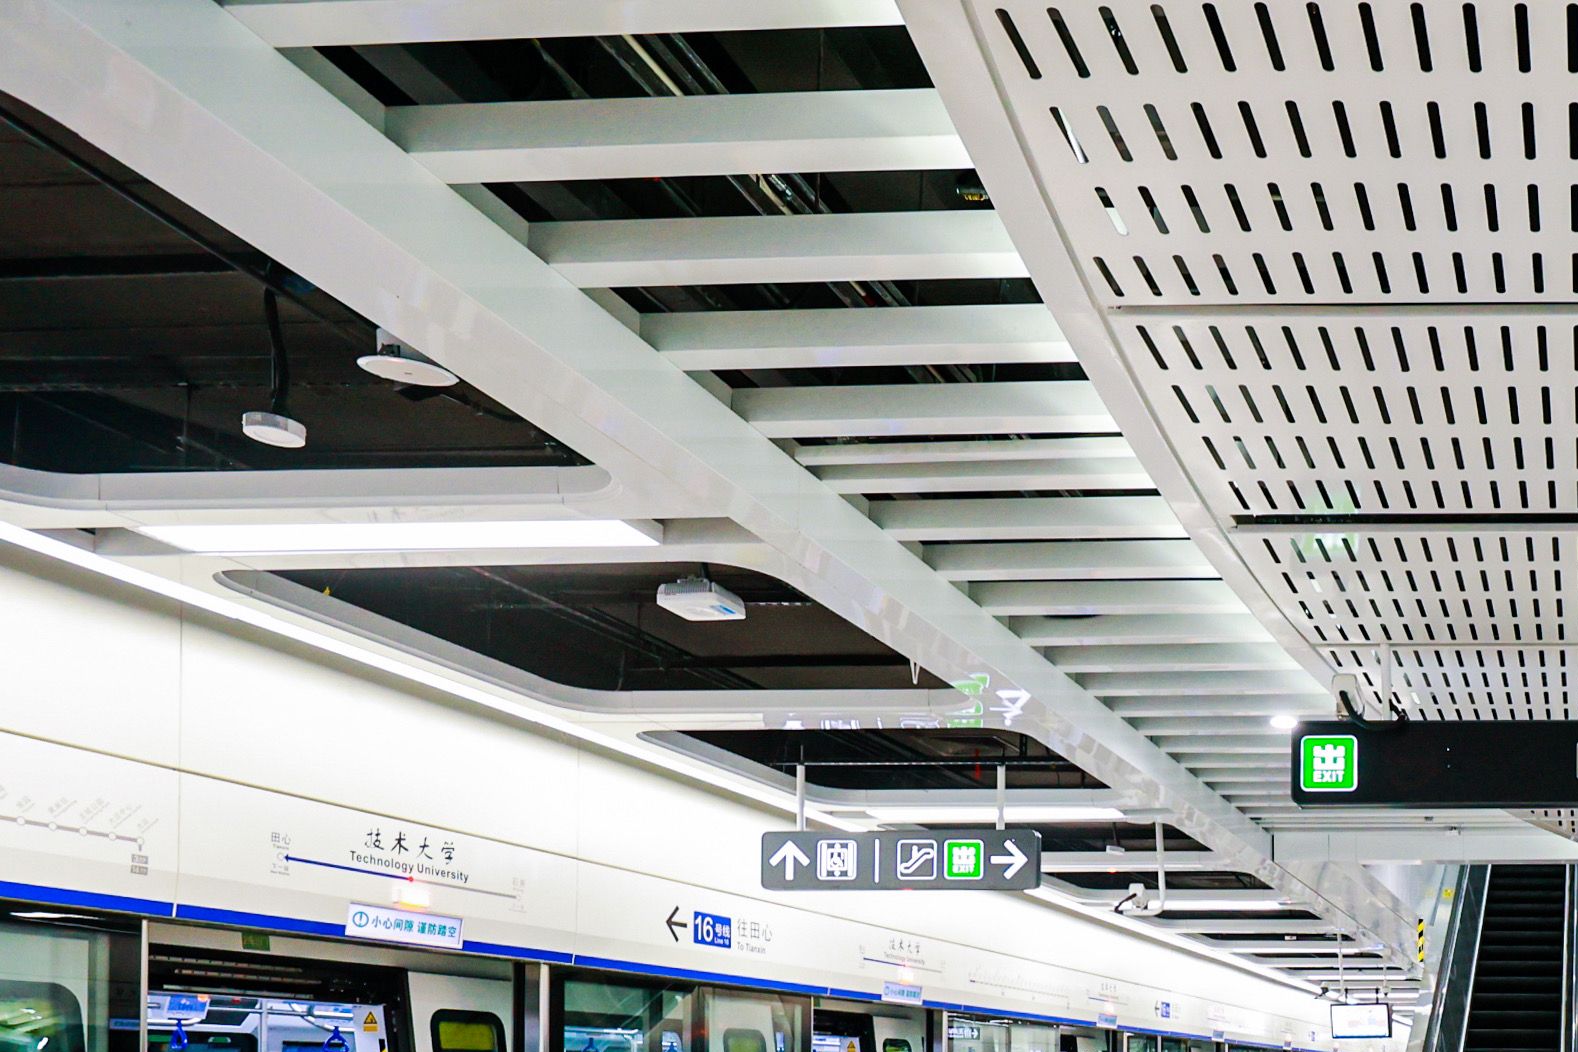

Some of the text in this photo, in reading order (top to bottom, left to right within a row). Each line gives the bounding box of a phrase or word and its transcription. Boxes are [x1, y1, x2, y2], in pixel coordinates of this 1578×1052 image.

[1313, 770, 1345, 783] EXIT
[271, 832, 291, 845] 田心
[365, 828, 456, 864] 技术大学
[350, 850, 470, 883] Technology University
[952, 864, 975, 873] EXIT
[371, 916, 457, 938] 小心间隙 谨防踏空
[737, 917, 772, 942] 往田心
[737, 942, 766, 954] To Tianxin
